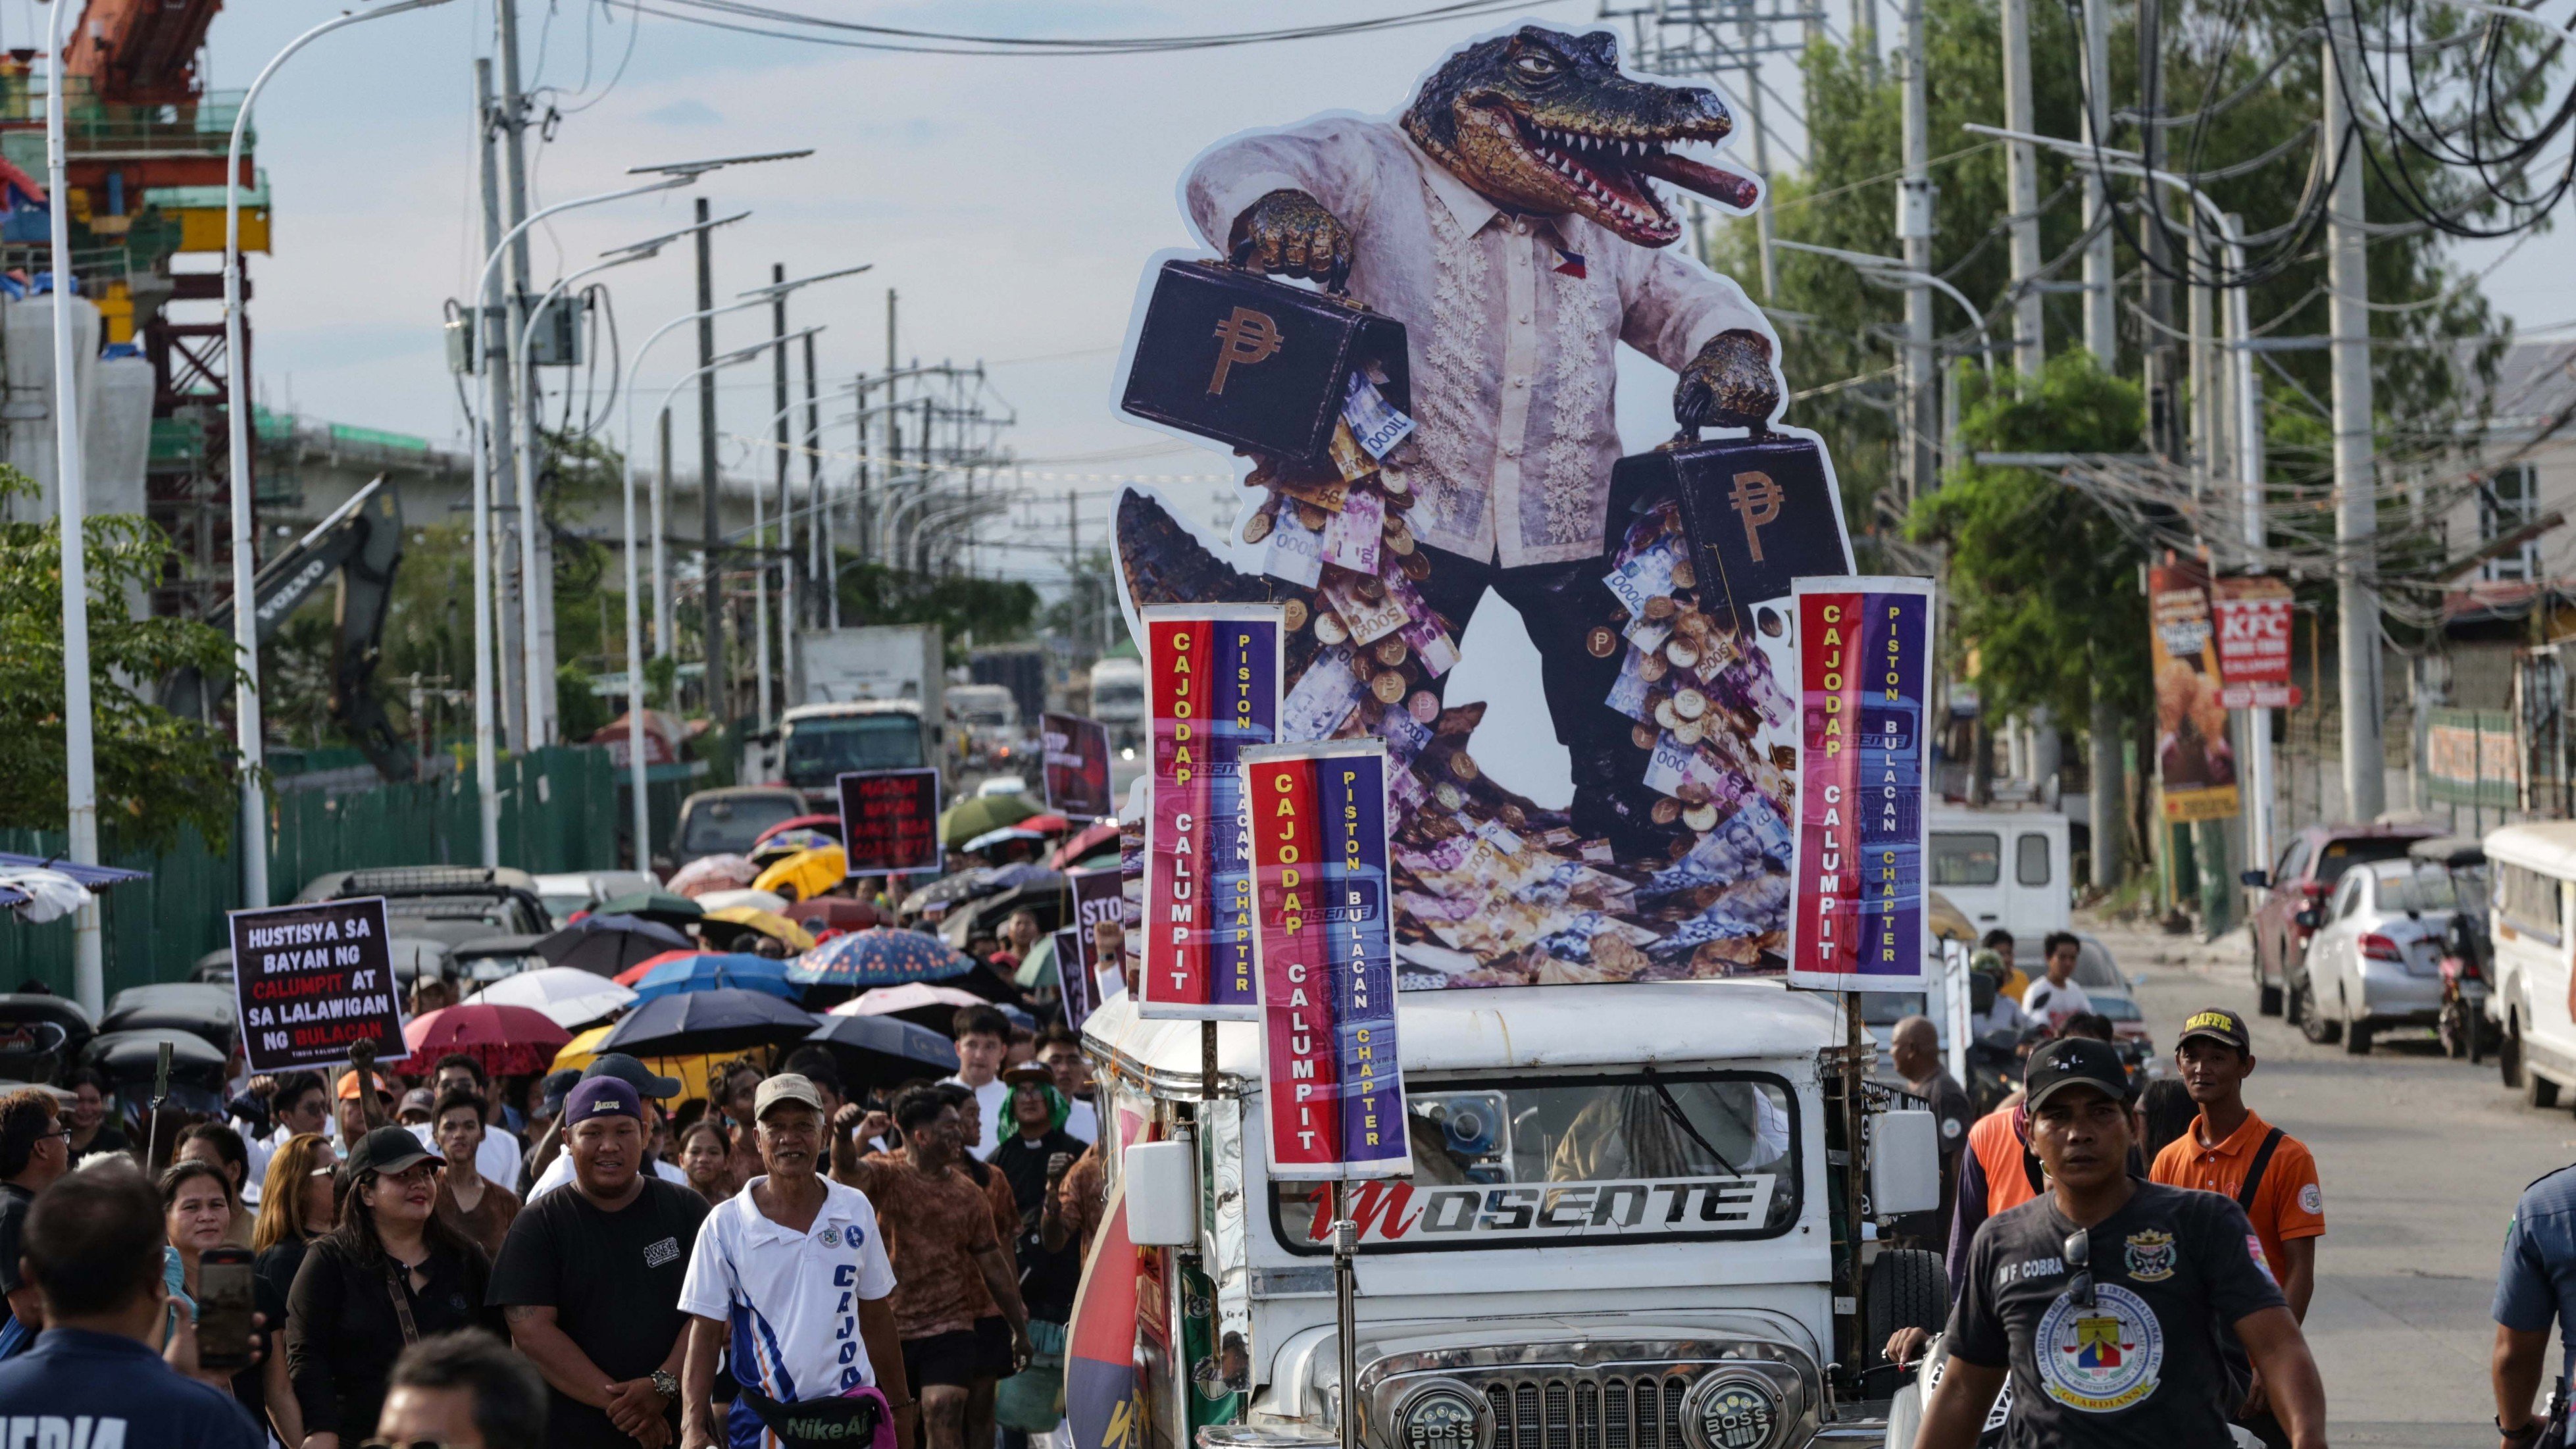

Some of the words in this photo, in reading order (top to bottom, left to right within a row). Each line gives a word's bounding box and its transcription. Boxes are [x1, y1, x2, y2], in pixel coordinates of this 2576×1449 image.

[1886, 607, 1900, 701] PISTON
[2222, 613, 2288, 638] KFC
[1173, 633, 1192, 786] CAJODAP
[1237, 634, 1250, 729] PISTON
[1823, 605, 1842, 758] CAJODAP
[1344, 771, 1360, 871] PISTON
[1883, 721, 1897, 831] BULACAN
[1171, 814, 1192, 990] CALUMPIT
[1819, 786, 1840, 959] CALUMPIT
[1882, 852, 1895, 961] CHAPTER
[249, 921, 339, 949] HUSTISYA
[345, 918, 371, 939] SA
[263, 949, 329, 974] BAYAN
[336, 945, 361, 966] NG
[1236, 880, 1249, 991] CHAPTER
[1275, 774, 1301, 935] CAJODAP
[1288, 964, 1315, 1150] CALUMPIT
[1349, 892, 1367, 1008] BULACAN
[249, 1007, 274, 1027] SA
[280, 994, 390, 1025] LALAWIGAN
[253, 973, 343, 1000] CALUMPIT
[352, 969, 376, 990] AT
[2185, 1011, 2232, 1033] TRAFFIC
[263, 1030, 288, 1052] NG
[295, 1022, 384, 1046] BULACAN
[1357, 1029, 1379, 1146] CHAPTER
[2022, 1257, 2064, 1278] COBRA
[0, 1415, 128, 1449] EDIA
[1412, 1423, 1473, 1439] BOSS
[1705, 1408, 1768, 1433] BOSS
[2061, 1389, 2140, 1408] GUARDIANS
